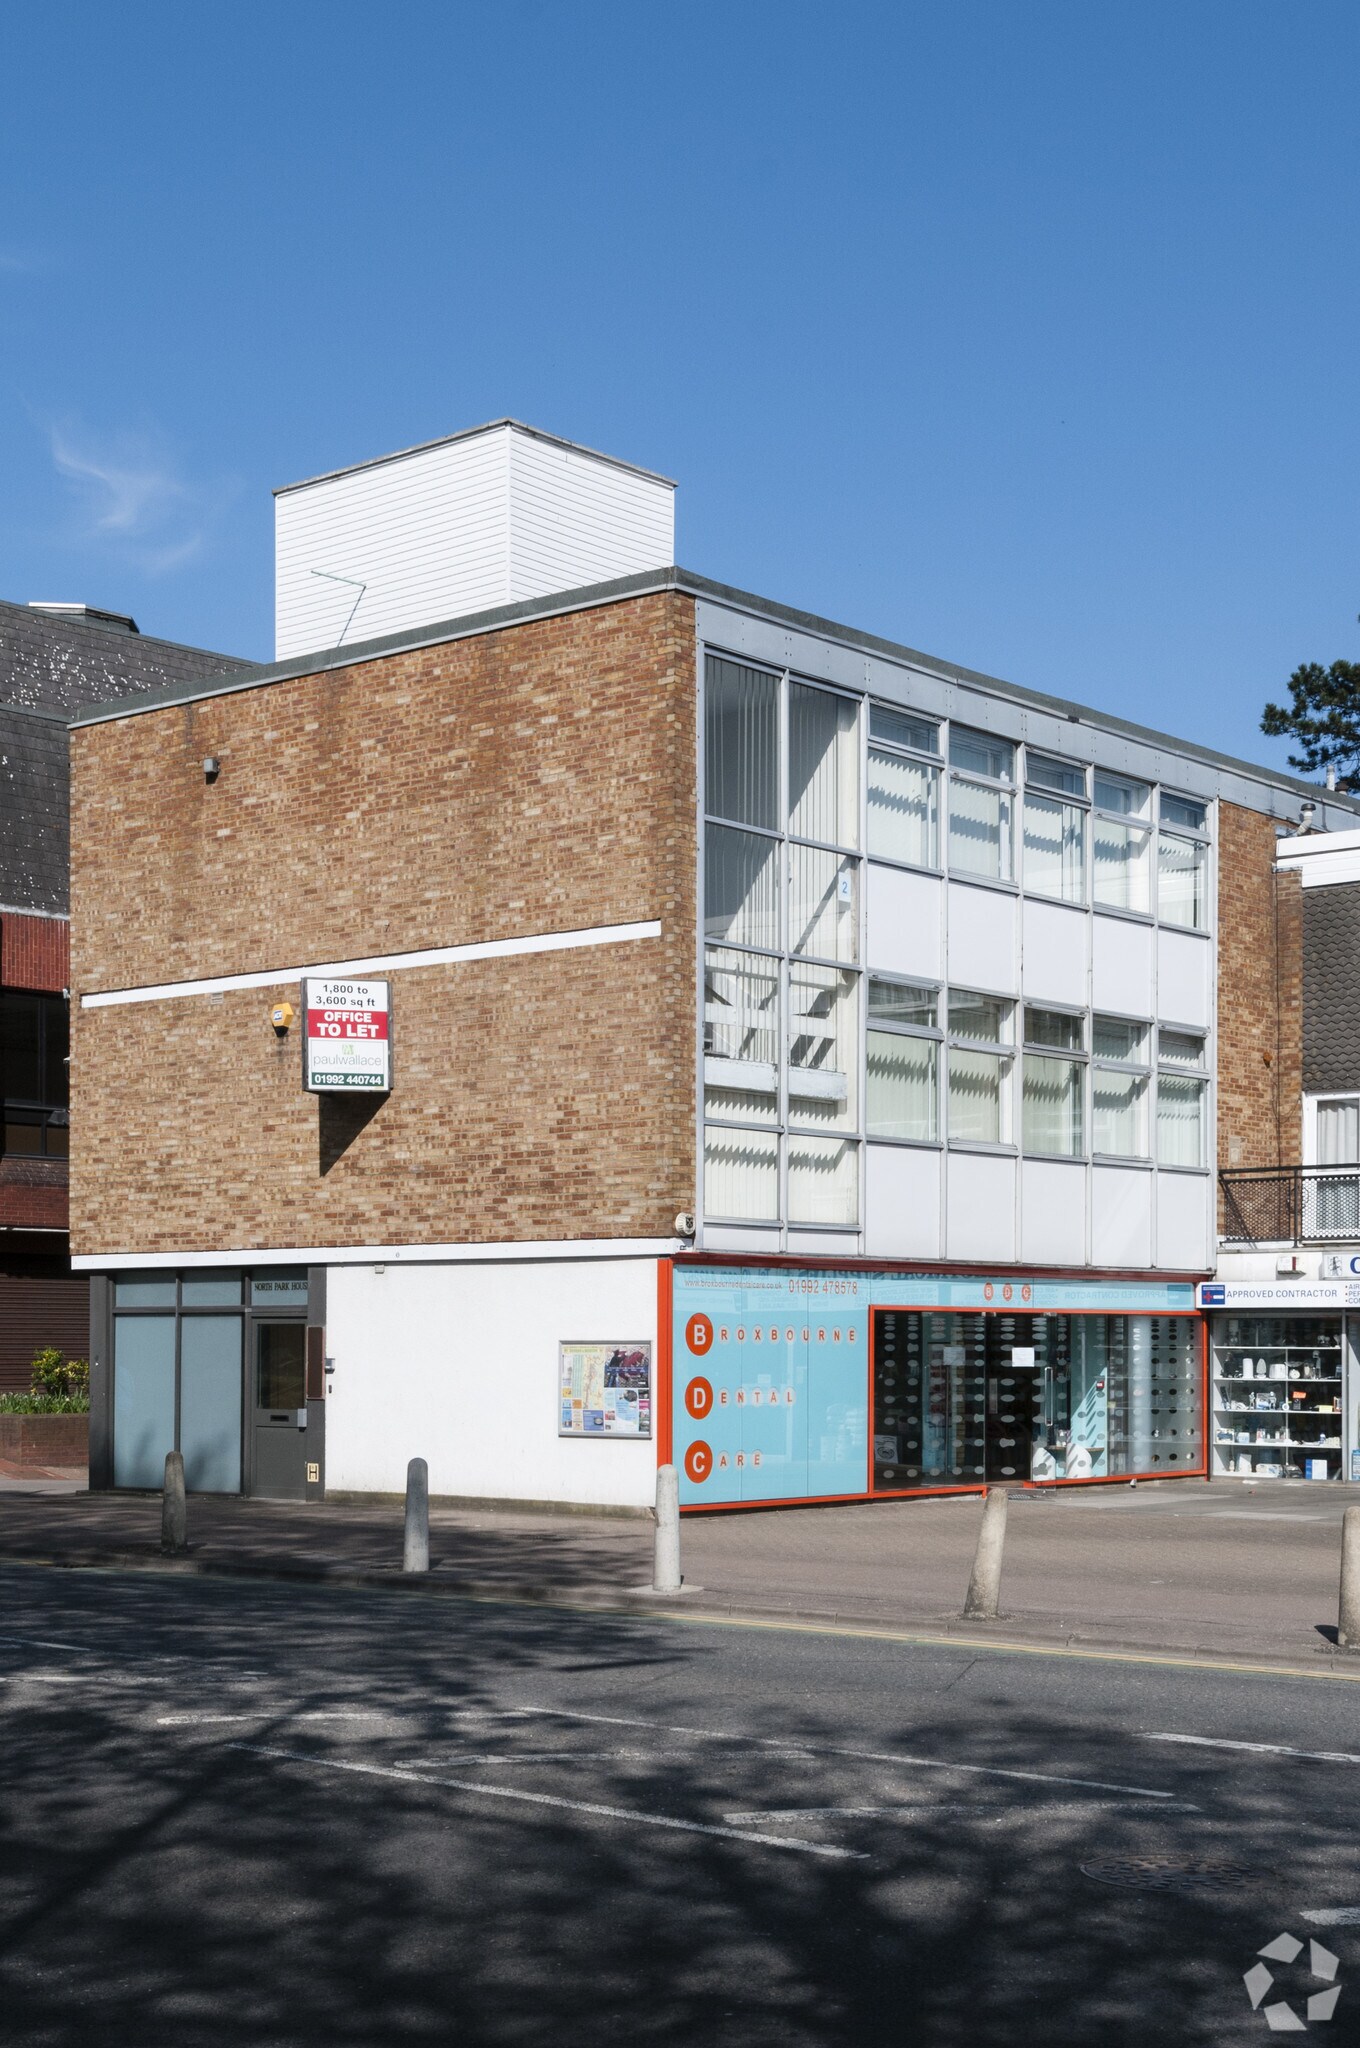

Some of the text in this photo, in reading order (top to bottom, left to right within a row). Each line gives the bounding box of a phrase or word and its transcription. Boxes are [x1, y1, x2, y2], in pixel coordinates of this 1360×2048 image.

[842, 881, 848, 894] 2
[323, 984, 368, 995] 1,800 to
[315, 995, 376, 1008] 3,600 sq ft
[323, 1010, 373, 1023] OFFICE
[316, 1022, 380, 1038] TO LET
[313, 1054, 382, 1067] paulwallace
[314, 1074, 382, 1086] 01992 440744
[254, 1282, 273, 1291] NORTH
[274, 1281, 290, 1291] PARK
[788, 1279, 819, 1294] 01992
[822, 1280, 858, 1296] 478578
[1226, 1290, 1273, 1298] APPROVED
[1275, 1289, 1338, 1298] CONTRACTOR
[692, 1324, 856, 1346] BROXBOURNE
[692, 1387, 793, 1410] DENTAL
[691, 1451, 761, 1474] CARE
